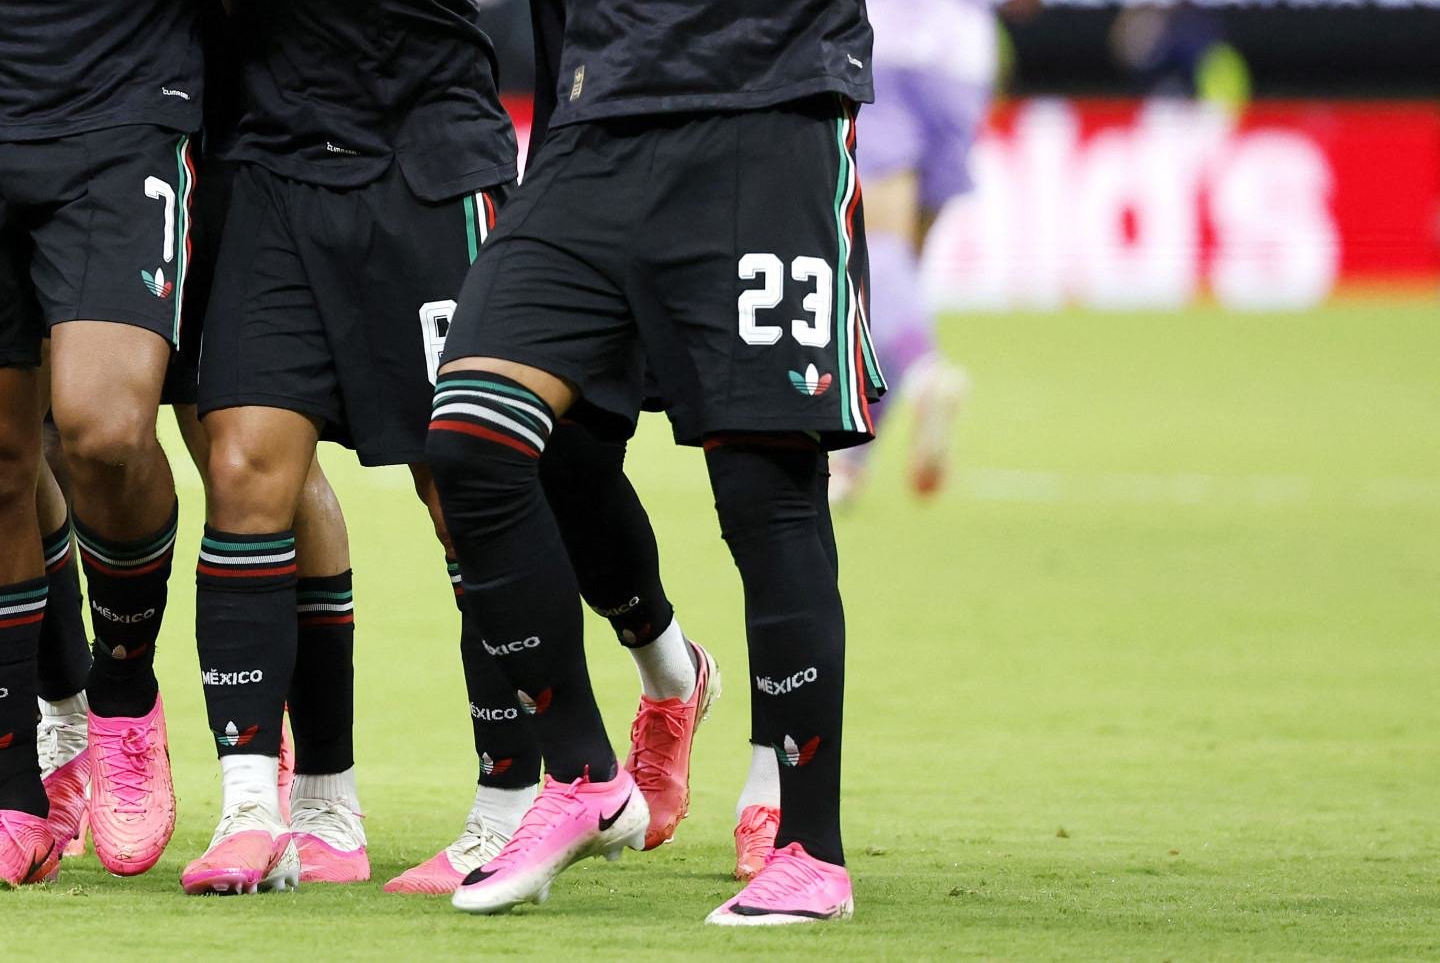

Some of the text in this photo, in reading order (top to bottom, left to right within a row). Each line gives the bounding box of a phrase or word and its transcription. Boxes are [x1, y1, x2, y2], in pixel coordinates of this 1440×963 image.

[144, 175, 176, 263] 7
[737, 252, 834, 347] 23
[201, 667, 263, 686] MÉXICO
[756, 666, 818, 696] MÉXICO
[470, 701, 518, 721] ÉXICO
